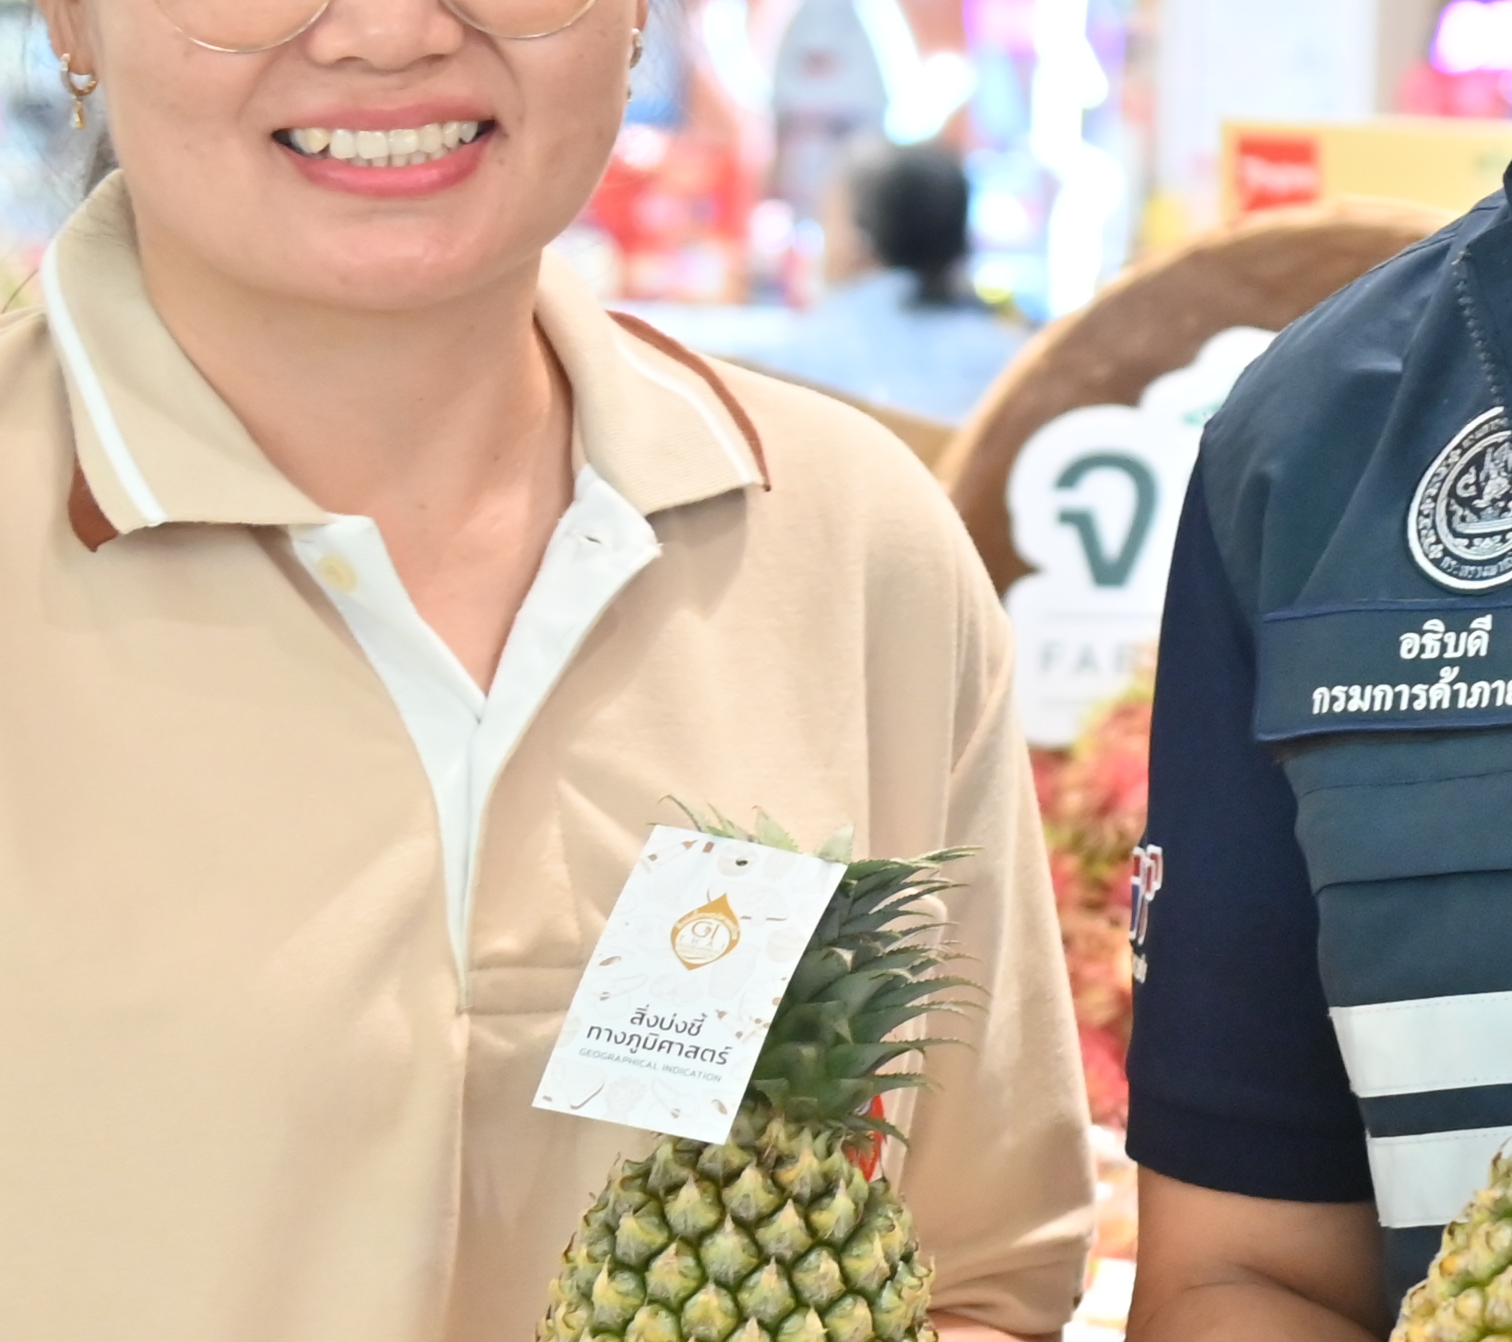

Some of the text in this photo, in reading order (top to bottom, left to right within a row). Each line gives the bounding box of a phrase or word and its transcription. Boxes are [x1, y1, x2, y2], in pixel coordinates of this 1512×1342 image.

[1399, 614, 1493, 660] อธิบดี
[629, 1003, 709, 1038] สิ่งบ่งชี้
[585, 1022, 734, 1067] ทางภูมิศาสตร์
[579, 1047, 722, 1083] GEOGRAPHICAL INDICATION
